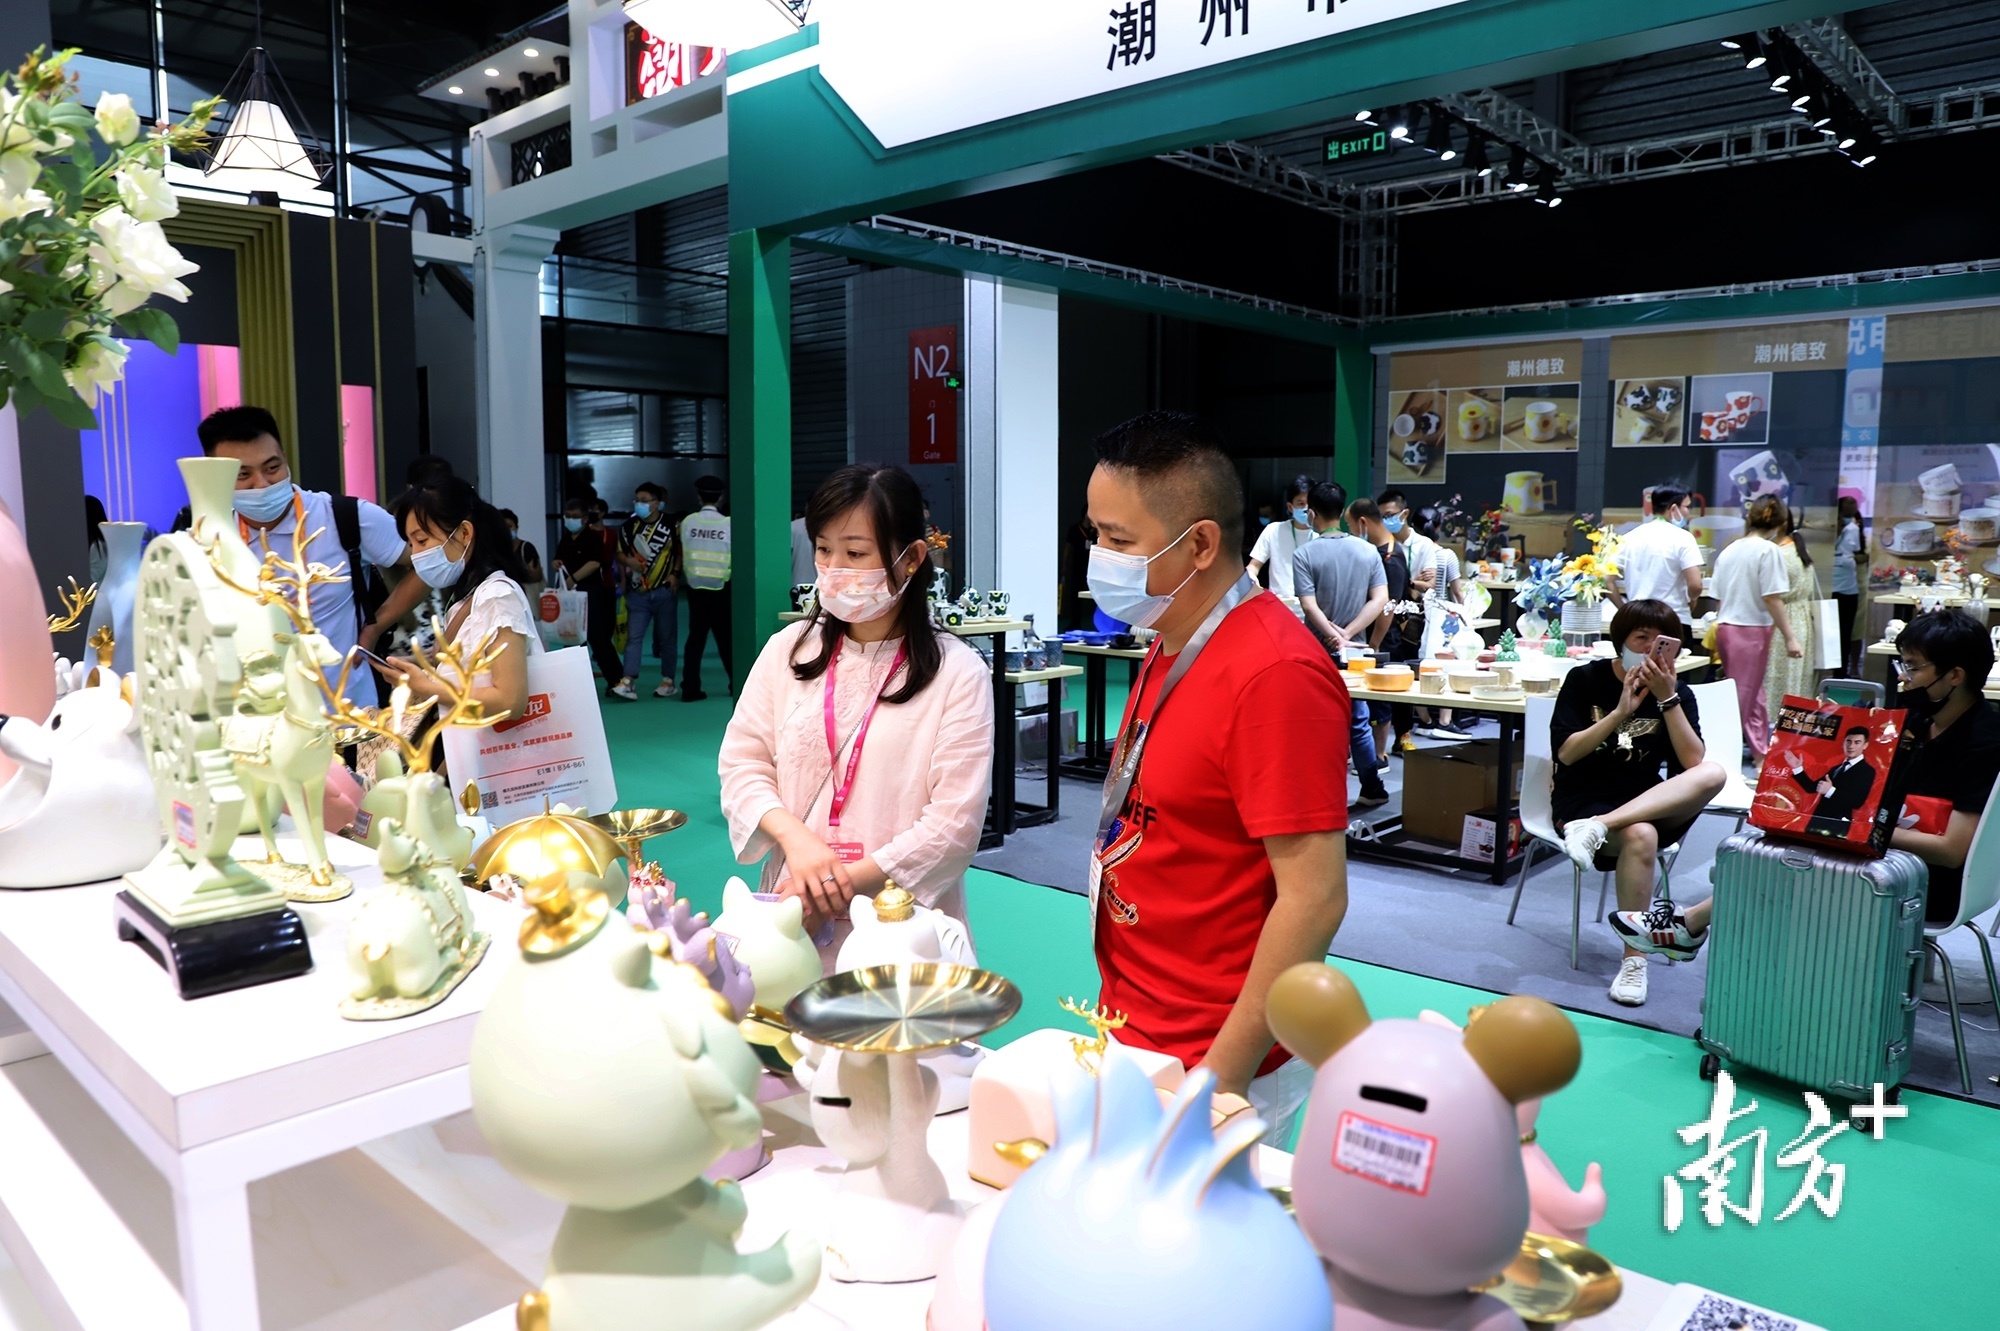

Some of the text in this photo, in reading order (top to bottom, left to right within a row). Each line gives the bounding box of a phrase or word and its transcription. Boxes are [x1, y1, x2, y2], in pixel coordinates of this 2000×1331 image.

[1328, 140, 1339, 160] 出
[1341, 138, 1370, 154] EXIT
[914, 344, 950, 380] N2
[1754, 341, 1828, 364] 潮州德致
[1506, 358, 1565, 377] 潮州德致
[927, 413, 935, 444] 1
[923, 450, 941, 460] Gate
[690, 527, 727, 541] SNIEC
